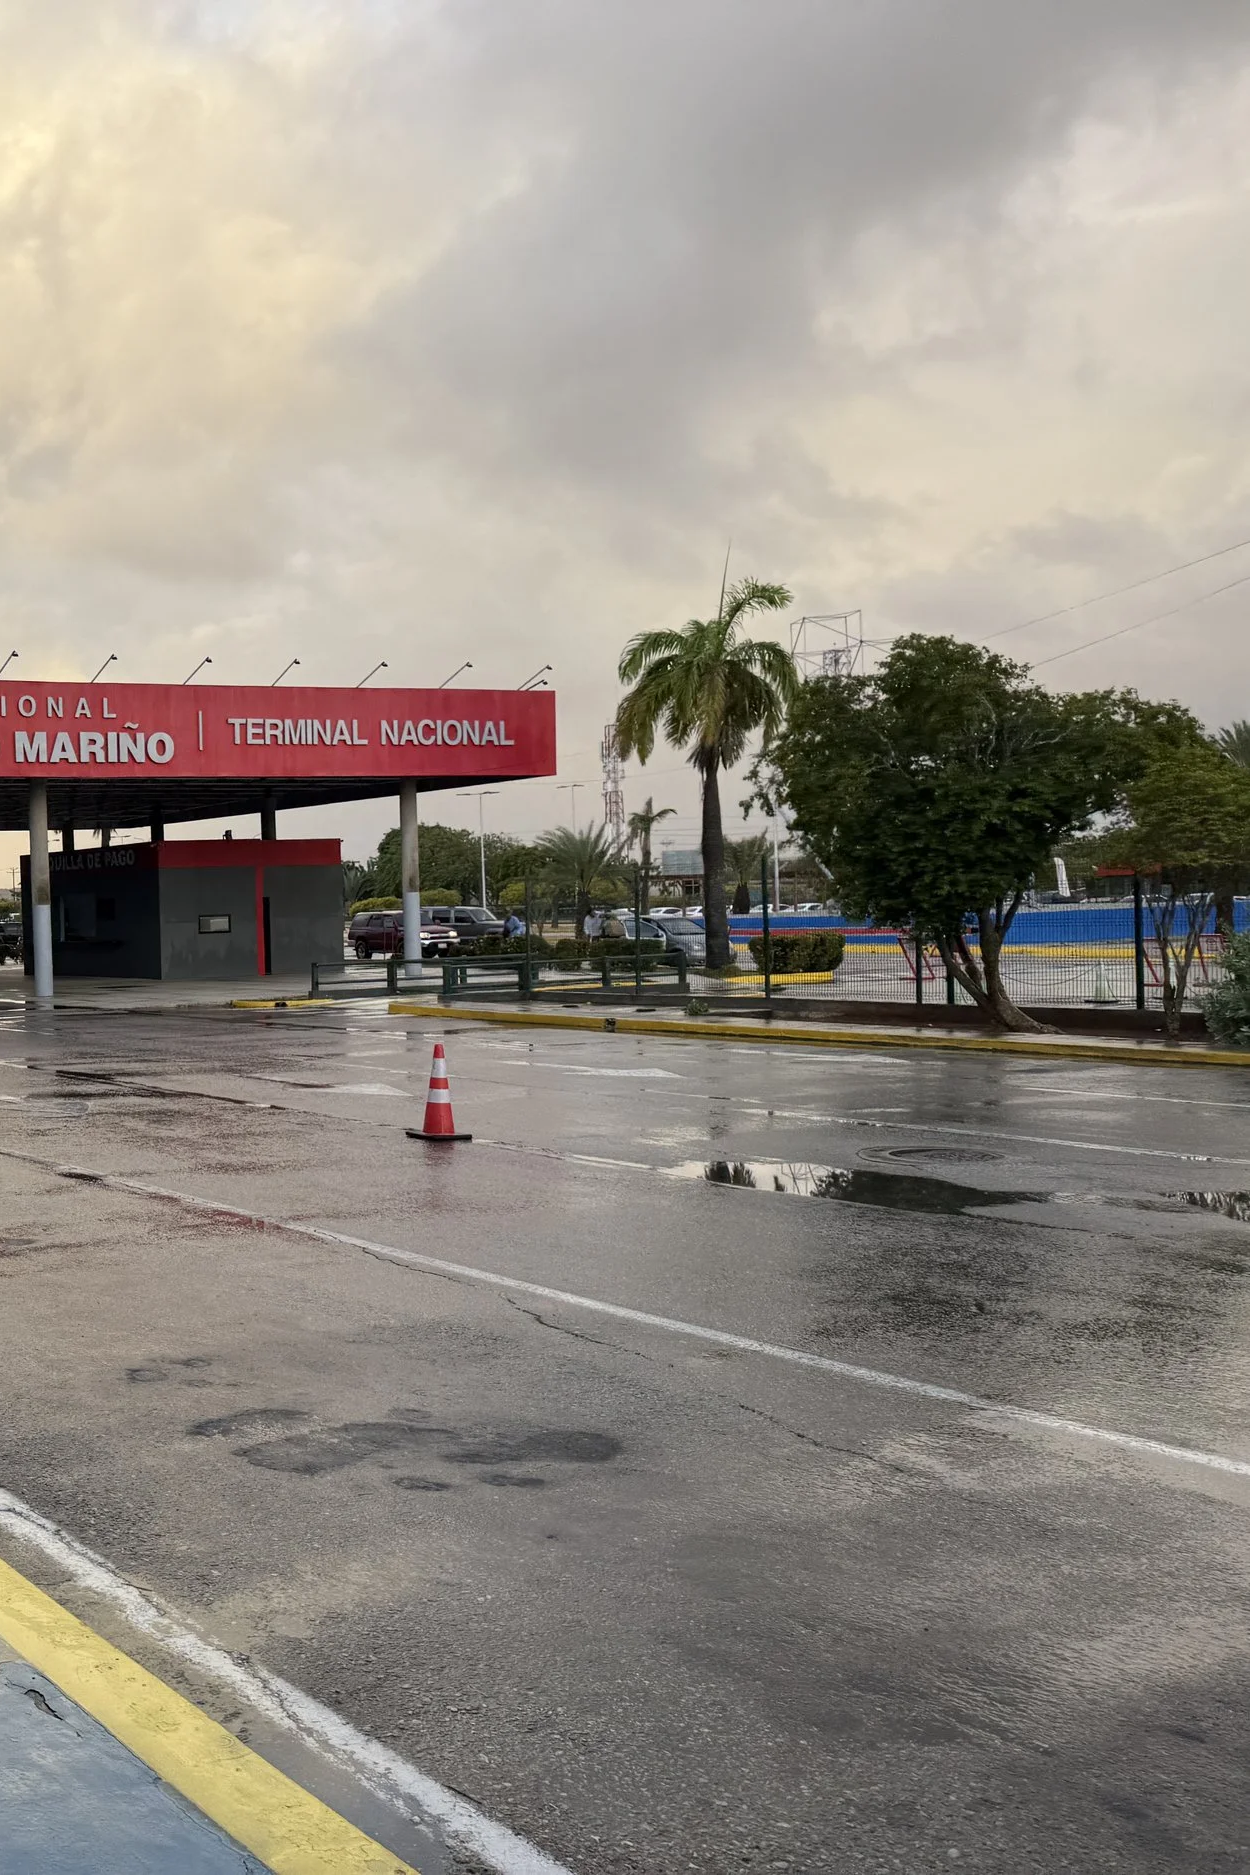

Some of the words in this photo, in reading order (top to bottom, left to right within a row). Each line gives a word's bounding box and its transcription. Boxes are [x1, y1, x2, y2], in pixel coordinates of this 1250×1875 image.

[14, 721, 175, 764] MARIÑO
[227, 718, 369, 746] TERMINAL
[380, 719, 516, 746] NACIONAL
[87, 854, 101, 869] DE
[105, 850, 135, 867] PAGO
